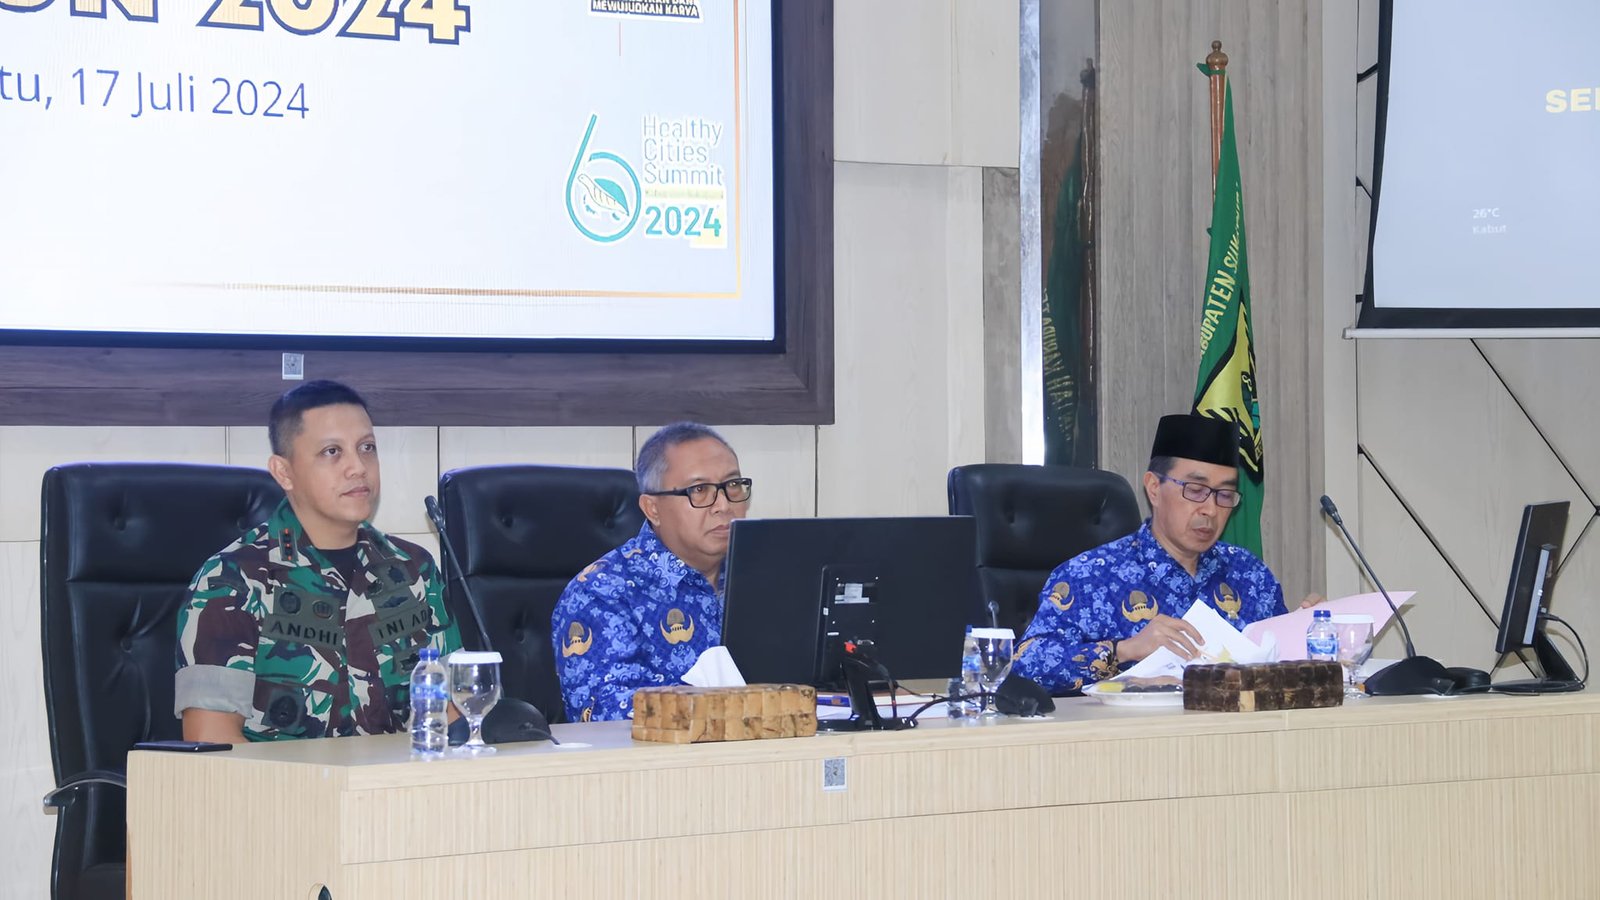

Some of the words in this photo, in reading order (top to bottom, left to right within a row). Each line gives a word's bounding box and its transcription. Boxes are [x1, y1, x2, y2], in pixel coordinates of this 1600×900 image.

[665, 5, 698, 17] KARYA
[72, 68, 119, 107] 17
[131, 72, 195, 118] Juli
[212, 78, 309, 119] 2024
[643, 116, 722, 145] Healthy
[644, 138, 707, 162] Cities
[644, 162, 722, 186] Summit
[645, 205, 722, 237] 2024
[271, 620, 338, 646] ANDHI
